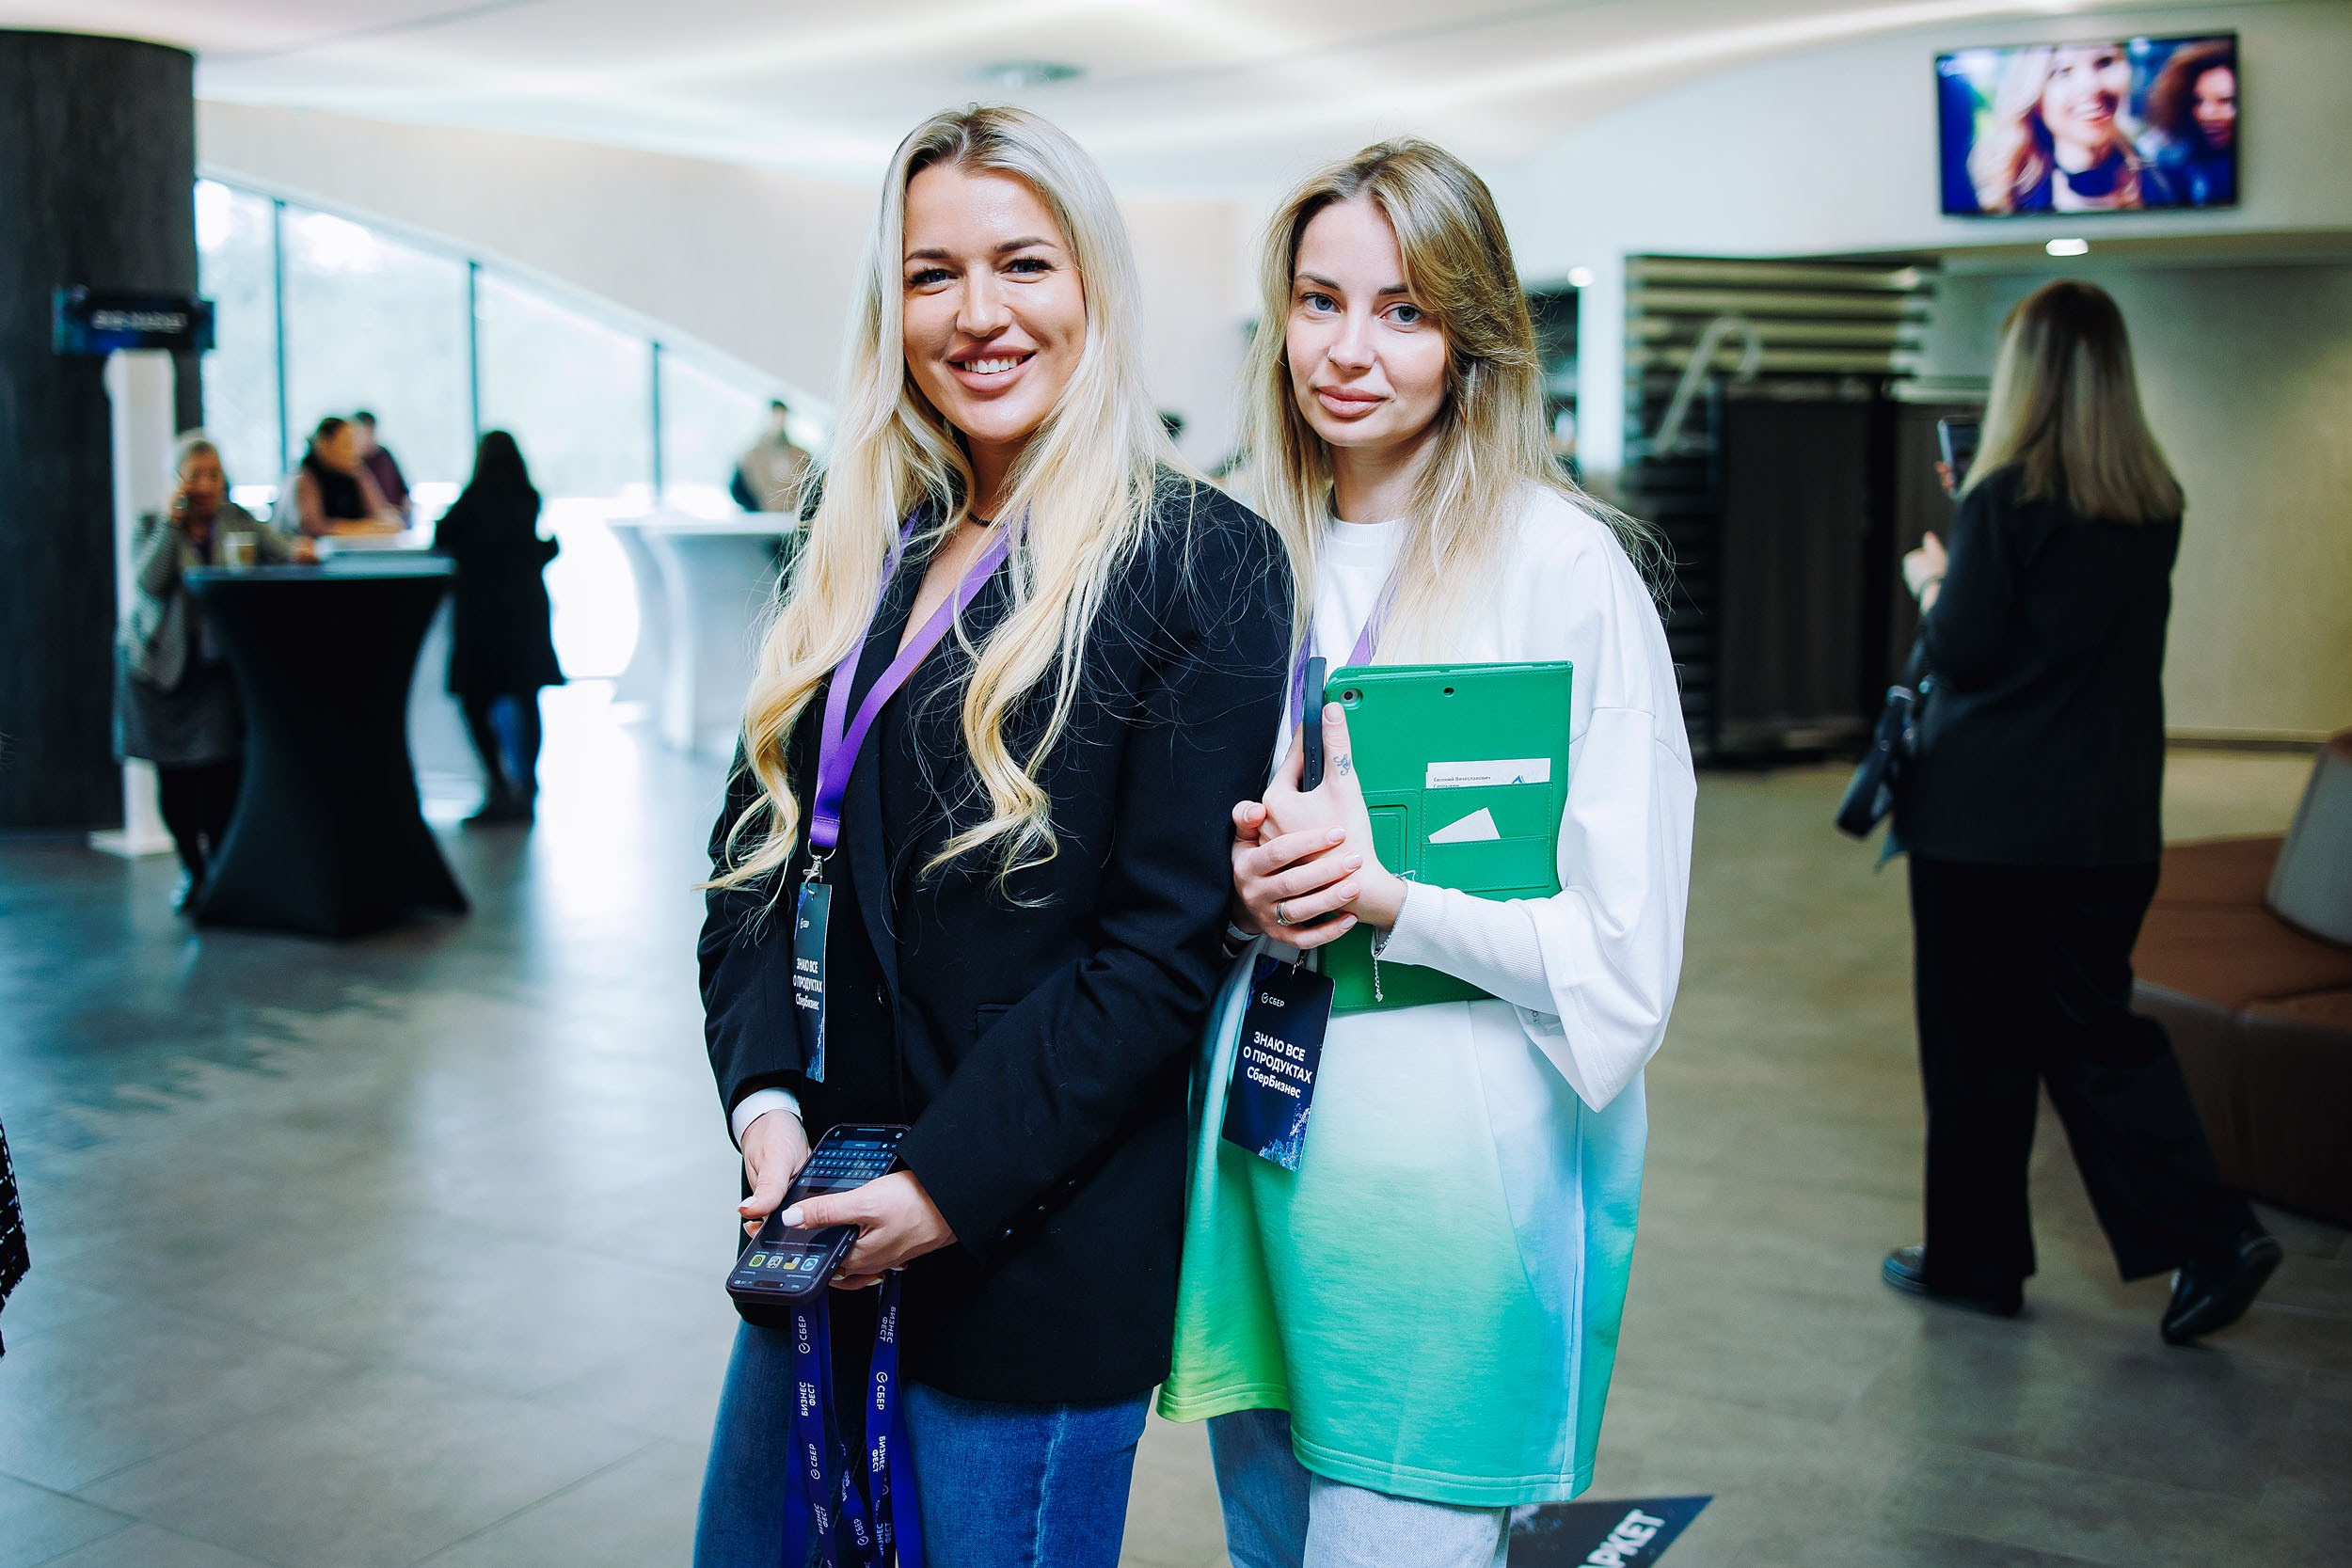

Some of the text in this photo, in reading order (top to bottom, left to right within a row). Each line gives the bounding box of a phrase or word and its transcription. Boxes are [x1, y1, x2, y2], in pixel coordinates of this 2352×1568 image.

[1269, 996, 1285, 1007] СБЕР
[1253, 1031, 1306, 1062] ЗНАЮ ВСЕ
[1243, 1046, 1313, 1085] О ПРОДУКТАХ
[1247, 1066, 1302, 1099] СберБизнес
[798, 1315, 807, 1340] СБЕР
[880, 1316, 888, 1342] ФЕСТ
[886, 1306, 897, 1344] БИЗНЕС
[799, 1381, 809, 1417] БИЗНЕС
[807, 1383, 817, 1406] ФЕСТ
[877, 1385, 885, 1410] СБЕР
[809, 1443, 818, 1467] СБЕР
[871, 1449, 880, 1473] ФЕСТ
[878, 1435, 886, 1471] БИЗНЕС
[853, 1518, 865, 1536] СБЕР
[1577, 1508, 1666, 1568] РКЕТ
